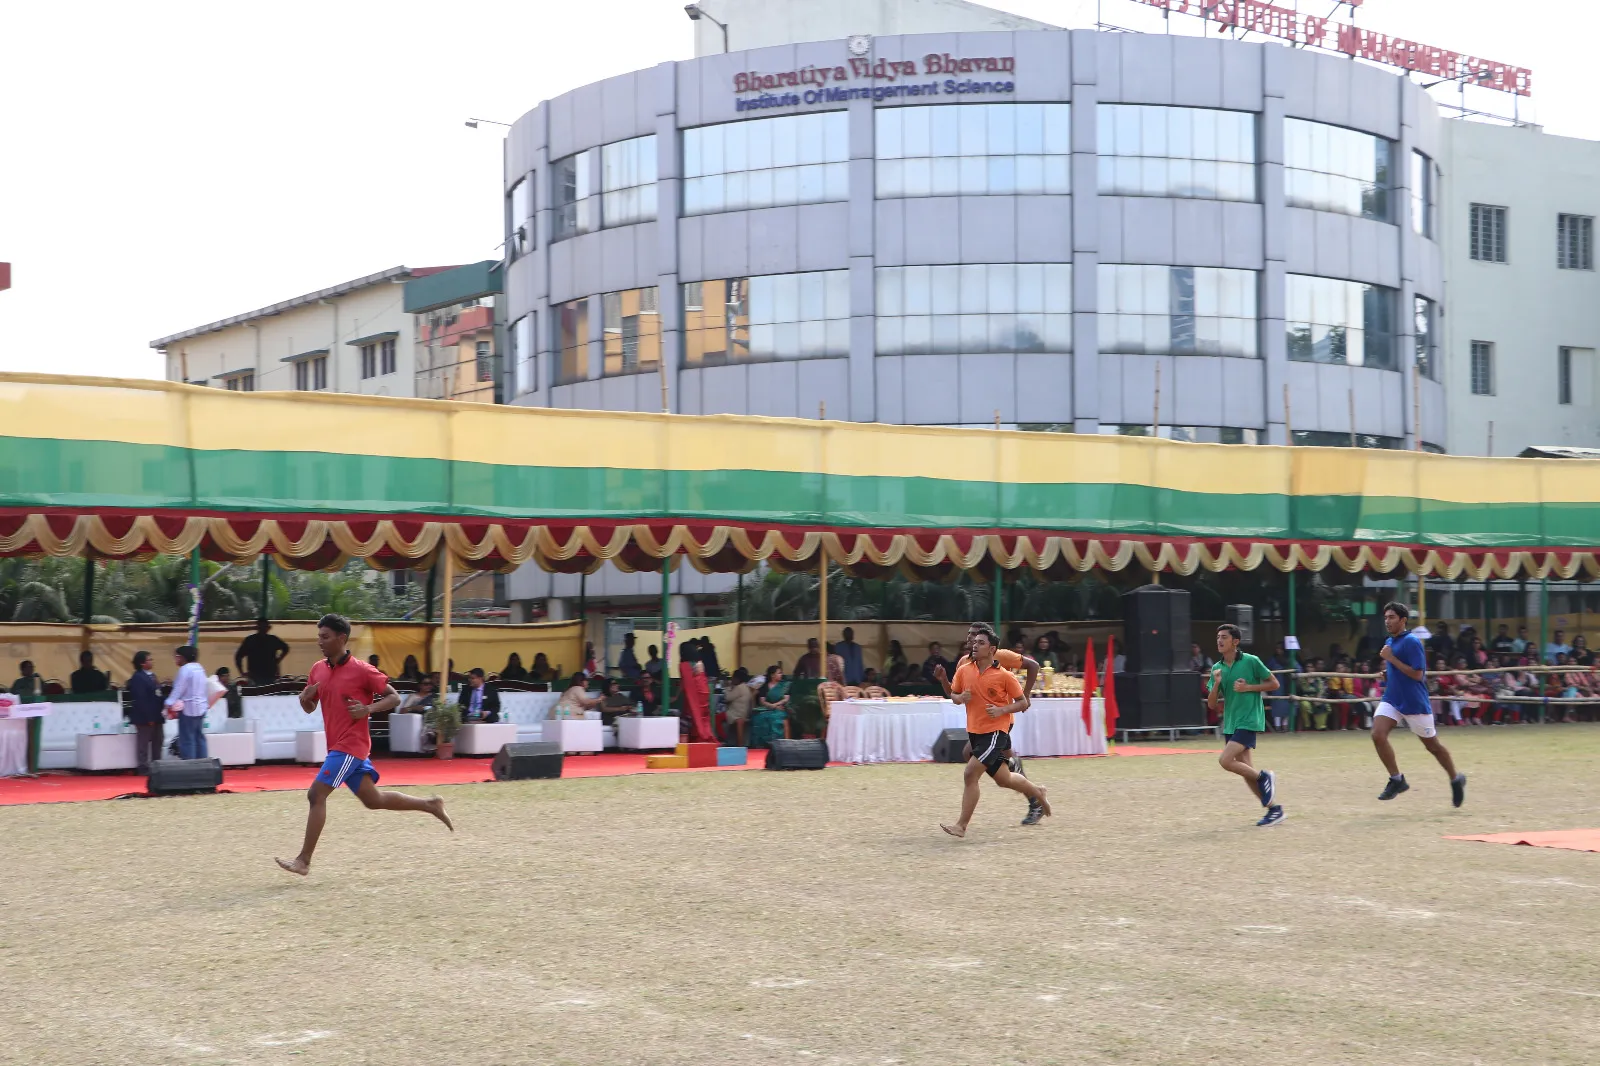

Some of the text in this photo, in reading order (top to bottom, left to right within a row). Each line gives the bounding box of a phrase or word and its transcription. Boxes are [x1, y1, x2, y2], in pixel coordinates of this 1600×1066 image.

[734, 53, 1015, 93] Bharatiya Vidya Bhavan
[735, 79, 1014, 112] Institute Of Management Science
